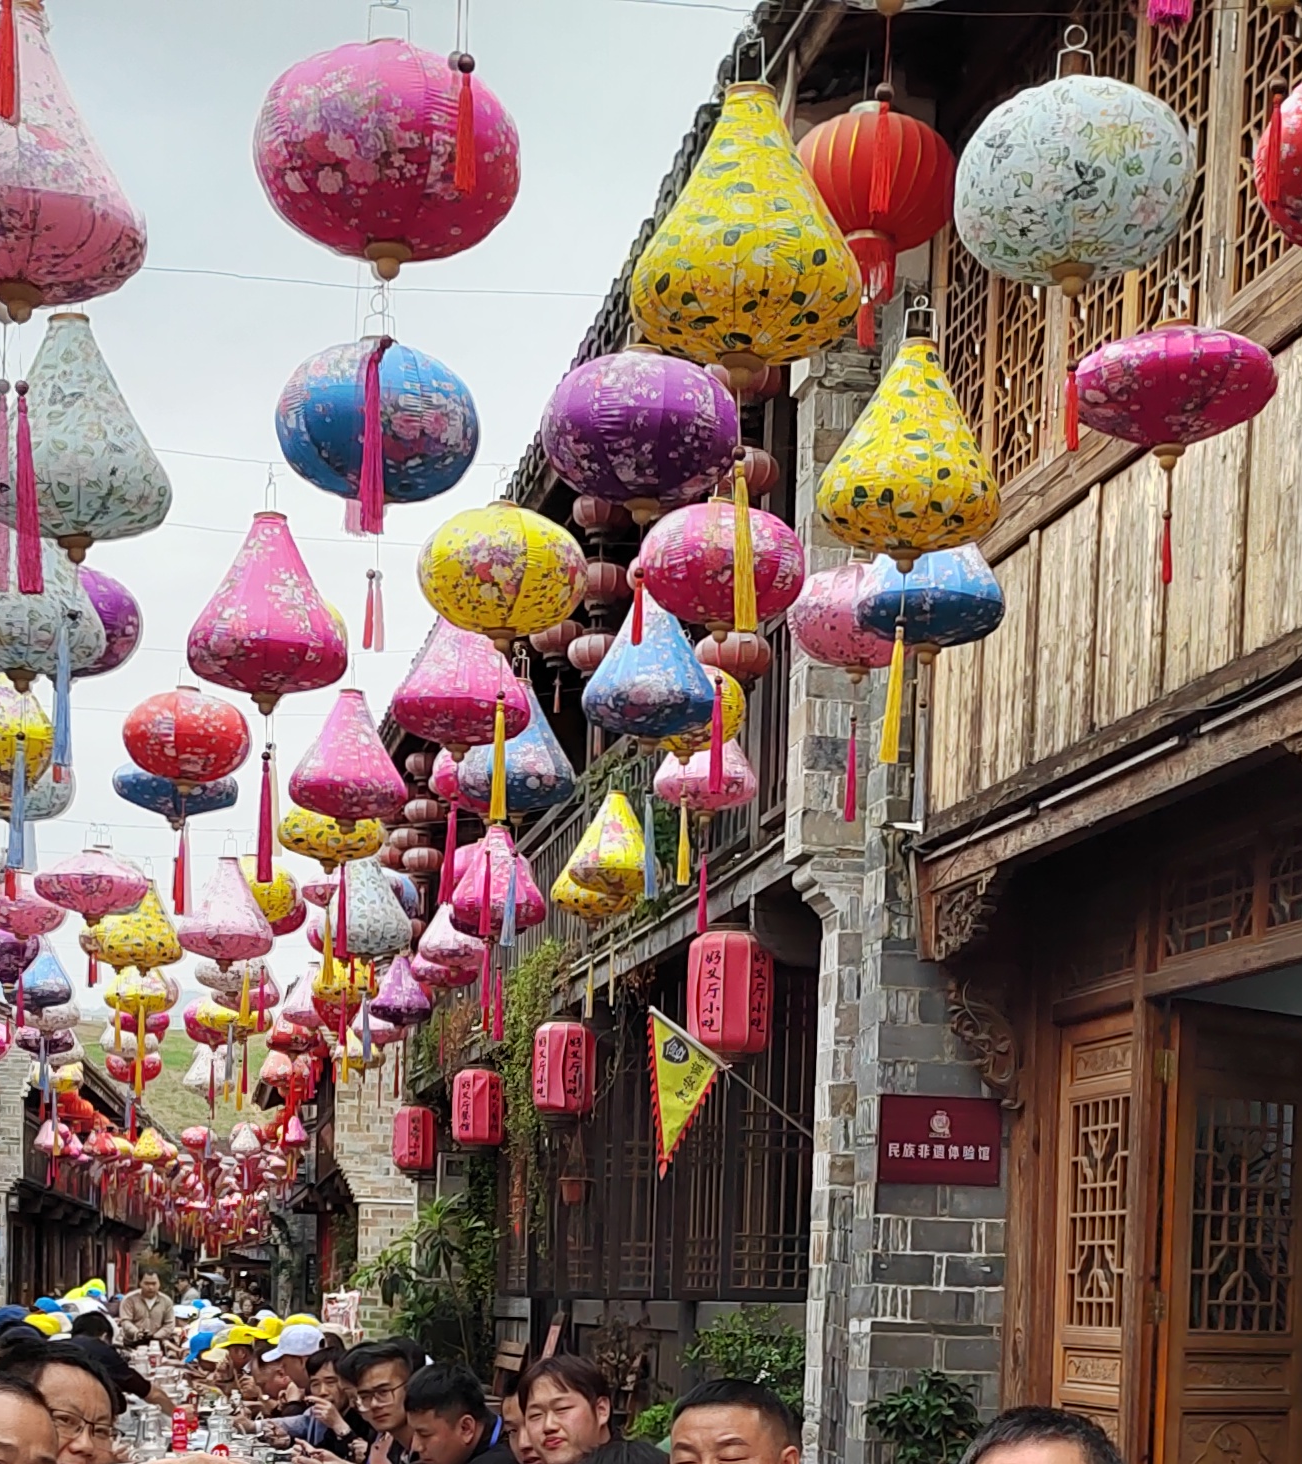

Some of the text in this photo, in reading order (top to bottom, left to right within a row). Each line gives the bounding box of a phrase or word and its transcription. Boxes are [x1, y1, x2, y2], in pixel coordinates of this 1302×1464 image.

[887, 1142, 991, 1161] 民族非遗体验馆
